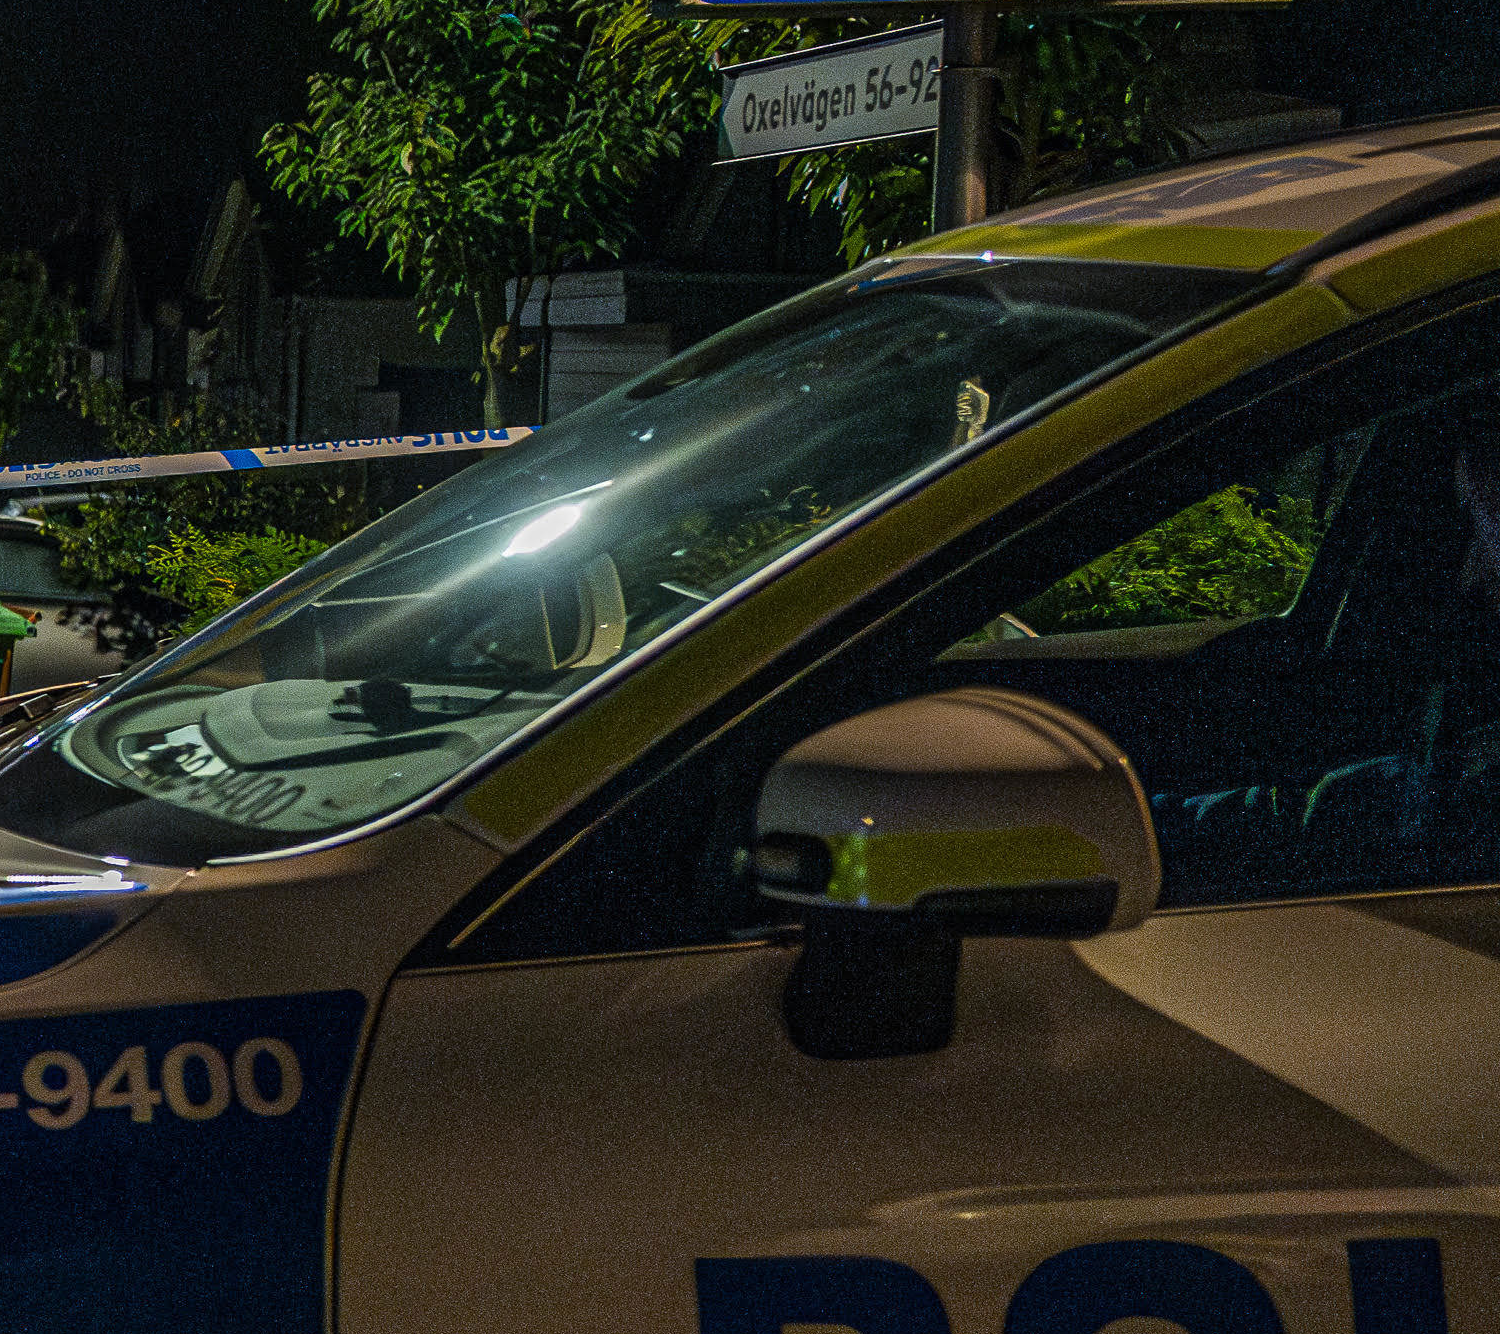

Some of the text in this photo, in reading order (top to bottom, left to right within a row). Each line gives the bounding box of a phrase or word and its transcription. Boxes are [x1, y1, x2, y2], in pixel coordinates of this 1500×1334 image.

[742, 55, 940, 133] Oxelvägen 56-92
[25, 471, 60, 481] POLICE
[68, 468, 83, 478] DO
[84, 467, 105, 477] NOT
[107, 464, 141, 475] CROSS
